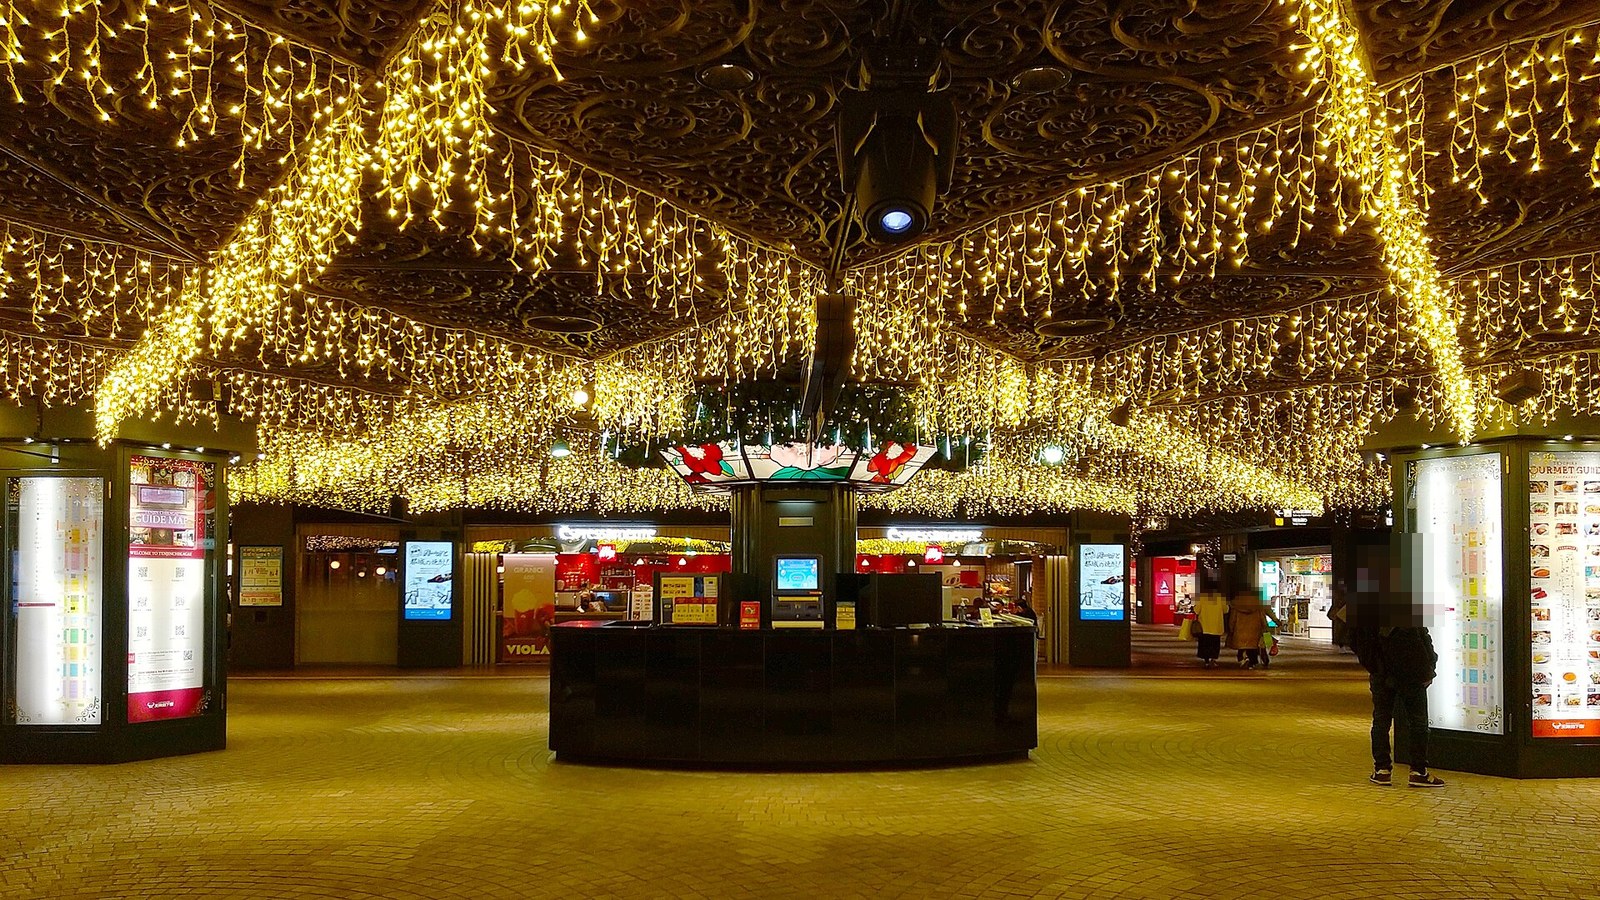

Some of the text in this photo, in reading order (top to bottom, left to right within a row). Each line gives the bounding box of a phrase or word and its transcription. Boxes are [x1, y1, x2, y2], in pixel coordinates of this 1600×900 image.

[134, 513, 189, 526] GUIDE MAP
[506, 644, 551, 655] VIOLA
